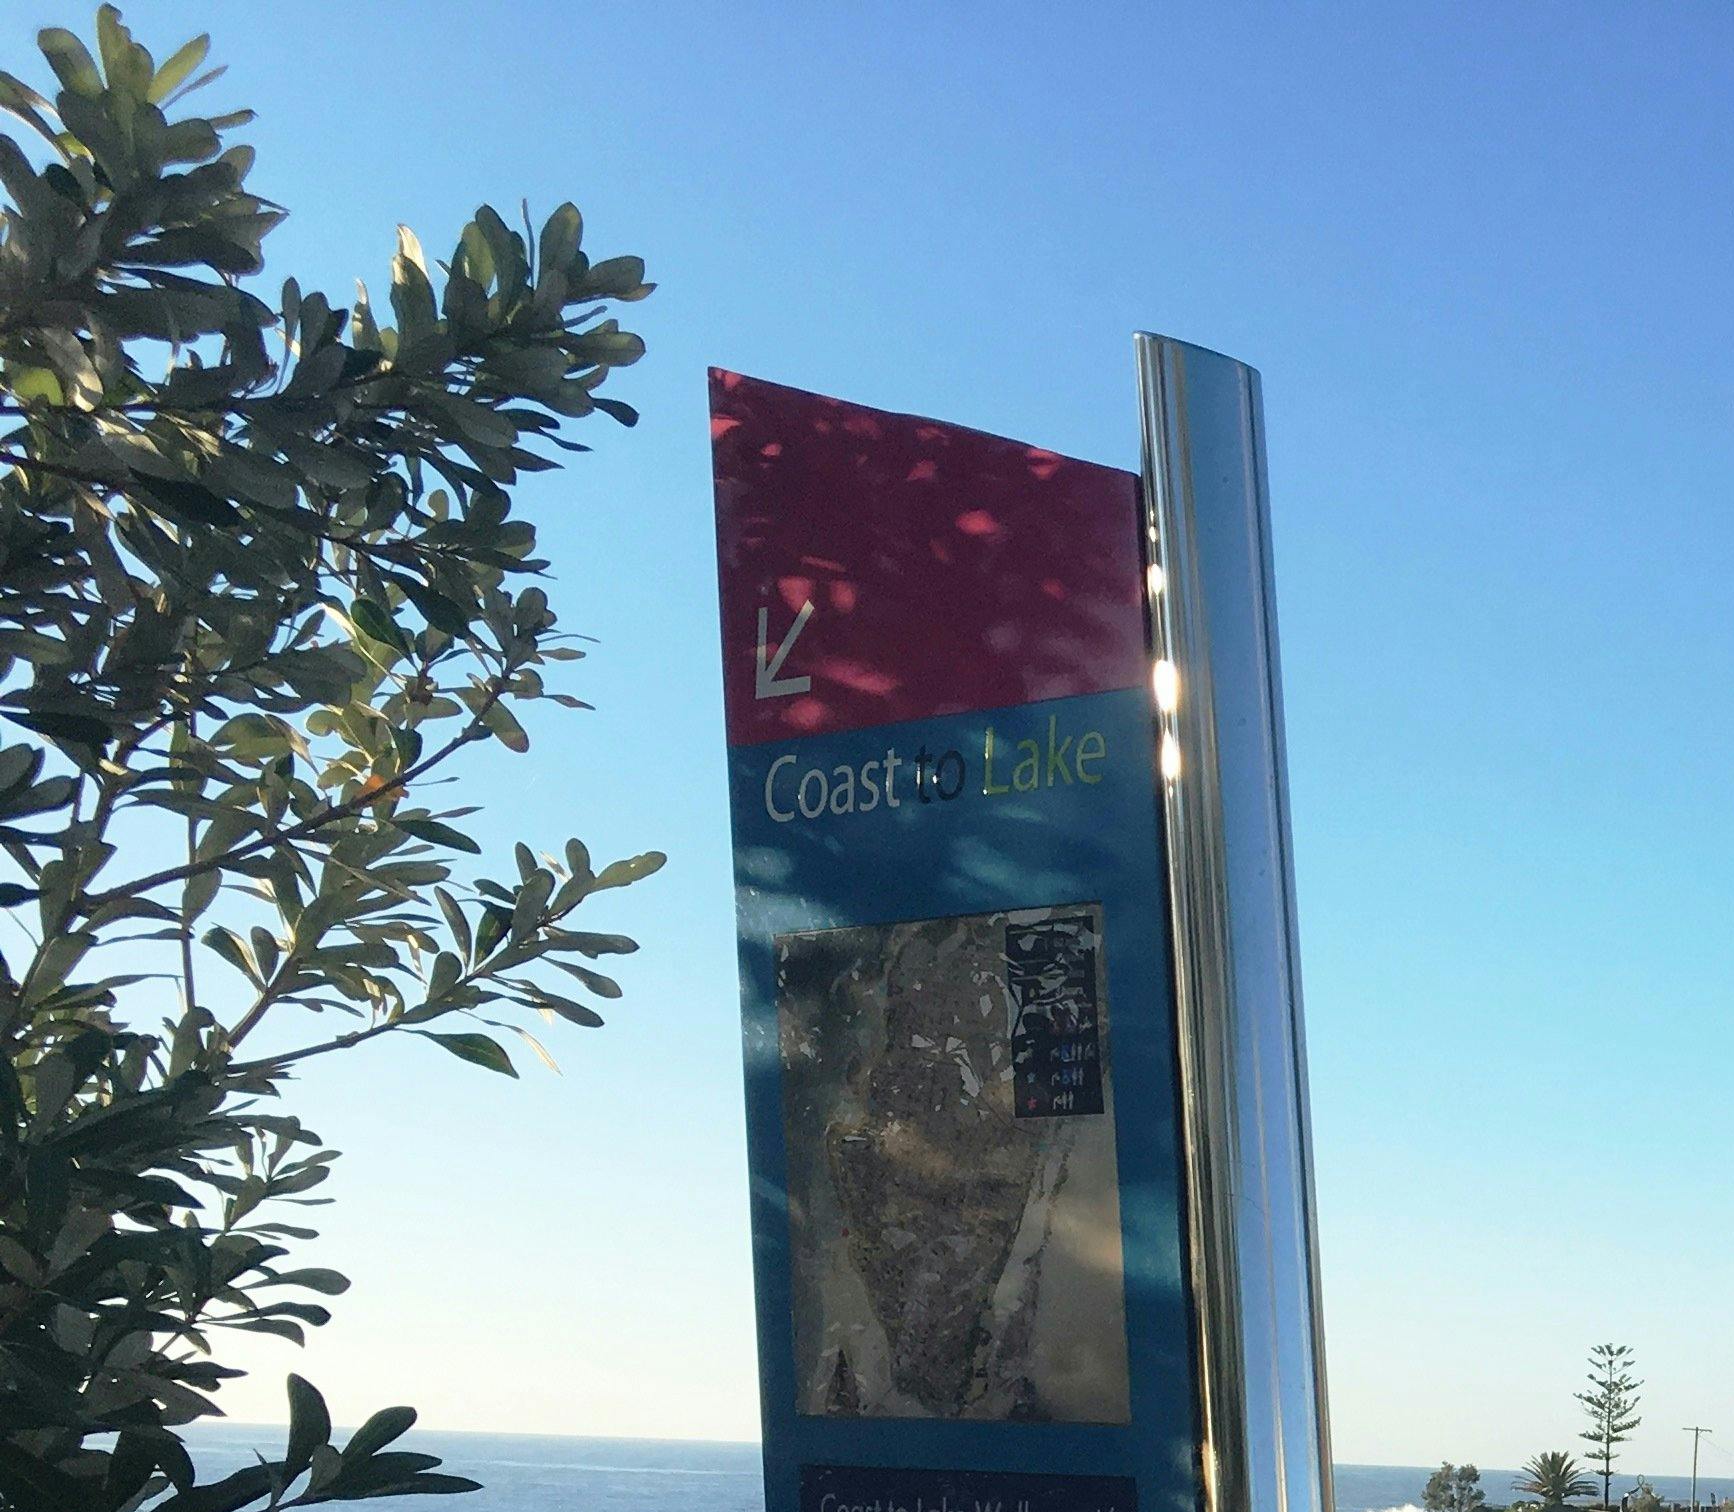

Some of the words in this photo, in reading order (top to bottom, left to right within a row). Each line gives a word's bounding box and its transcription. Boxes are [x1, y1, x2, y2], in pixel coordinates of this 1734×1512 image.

[765, 747, 902, 822] Coast
[914, 745, 966, 804] to
[982, 715, 1107, 796] Lake
